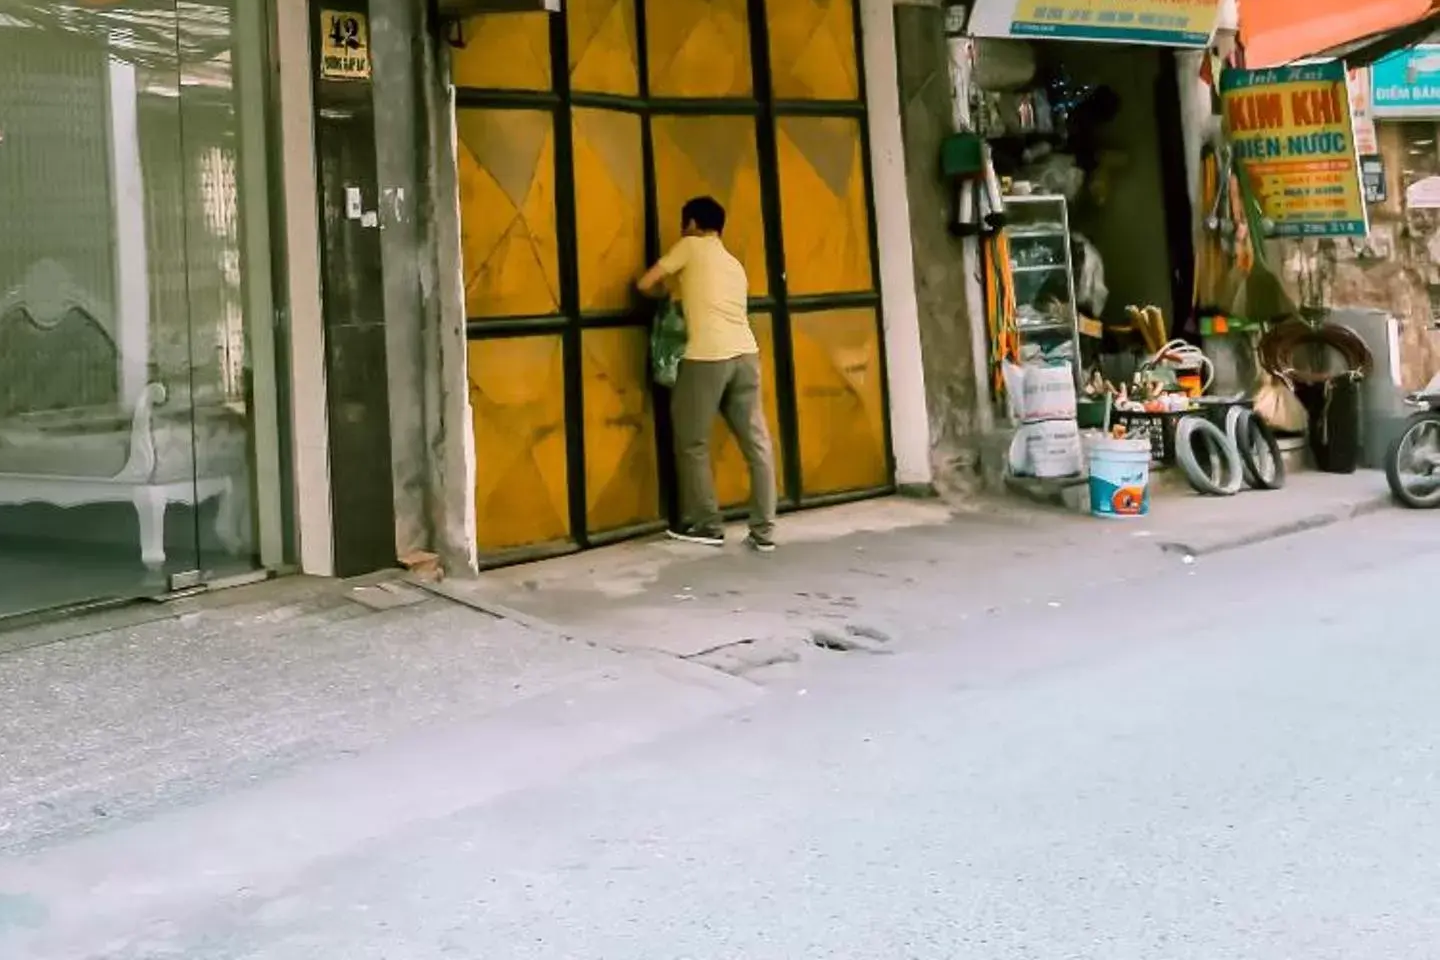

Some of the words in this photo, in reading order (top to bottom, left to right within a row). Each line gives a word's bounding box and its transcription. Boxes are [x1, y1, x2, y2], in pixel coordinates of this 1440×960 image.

[328, 15, 362, 50] 42
[1228, 93, 1283, 131] KIM
[1291, 82, 1342, 127] KHÍ
